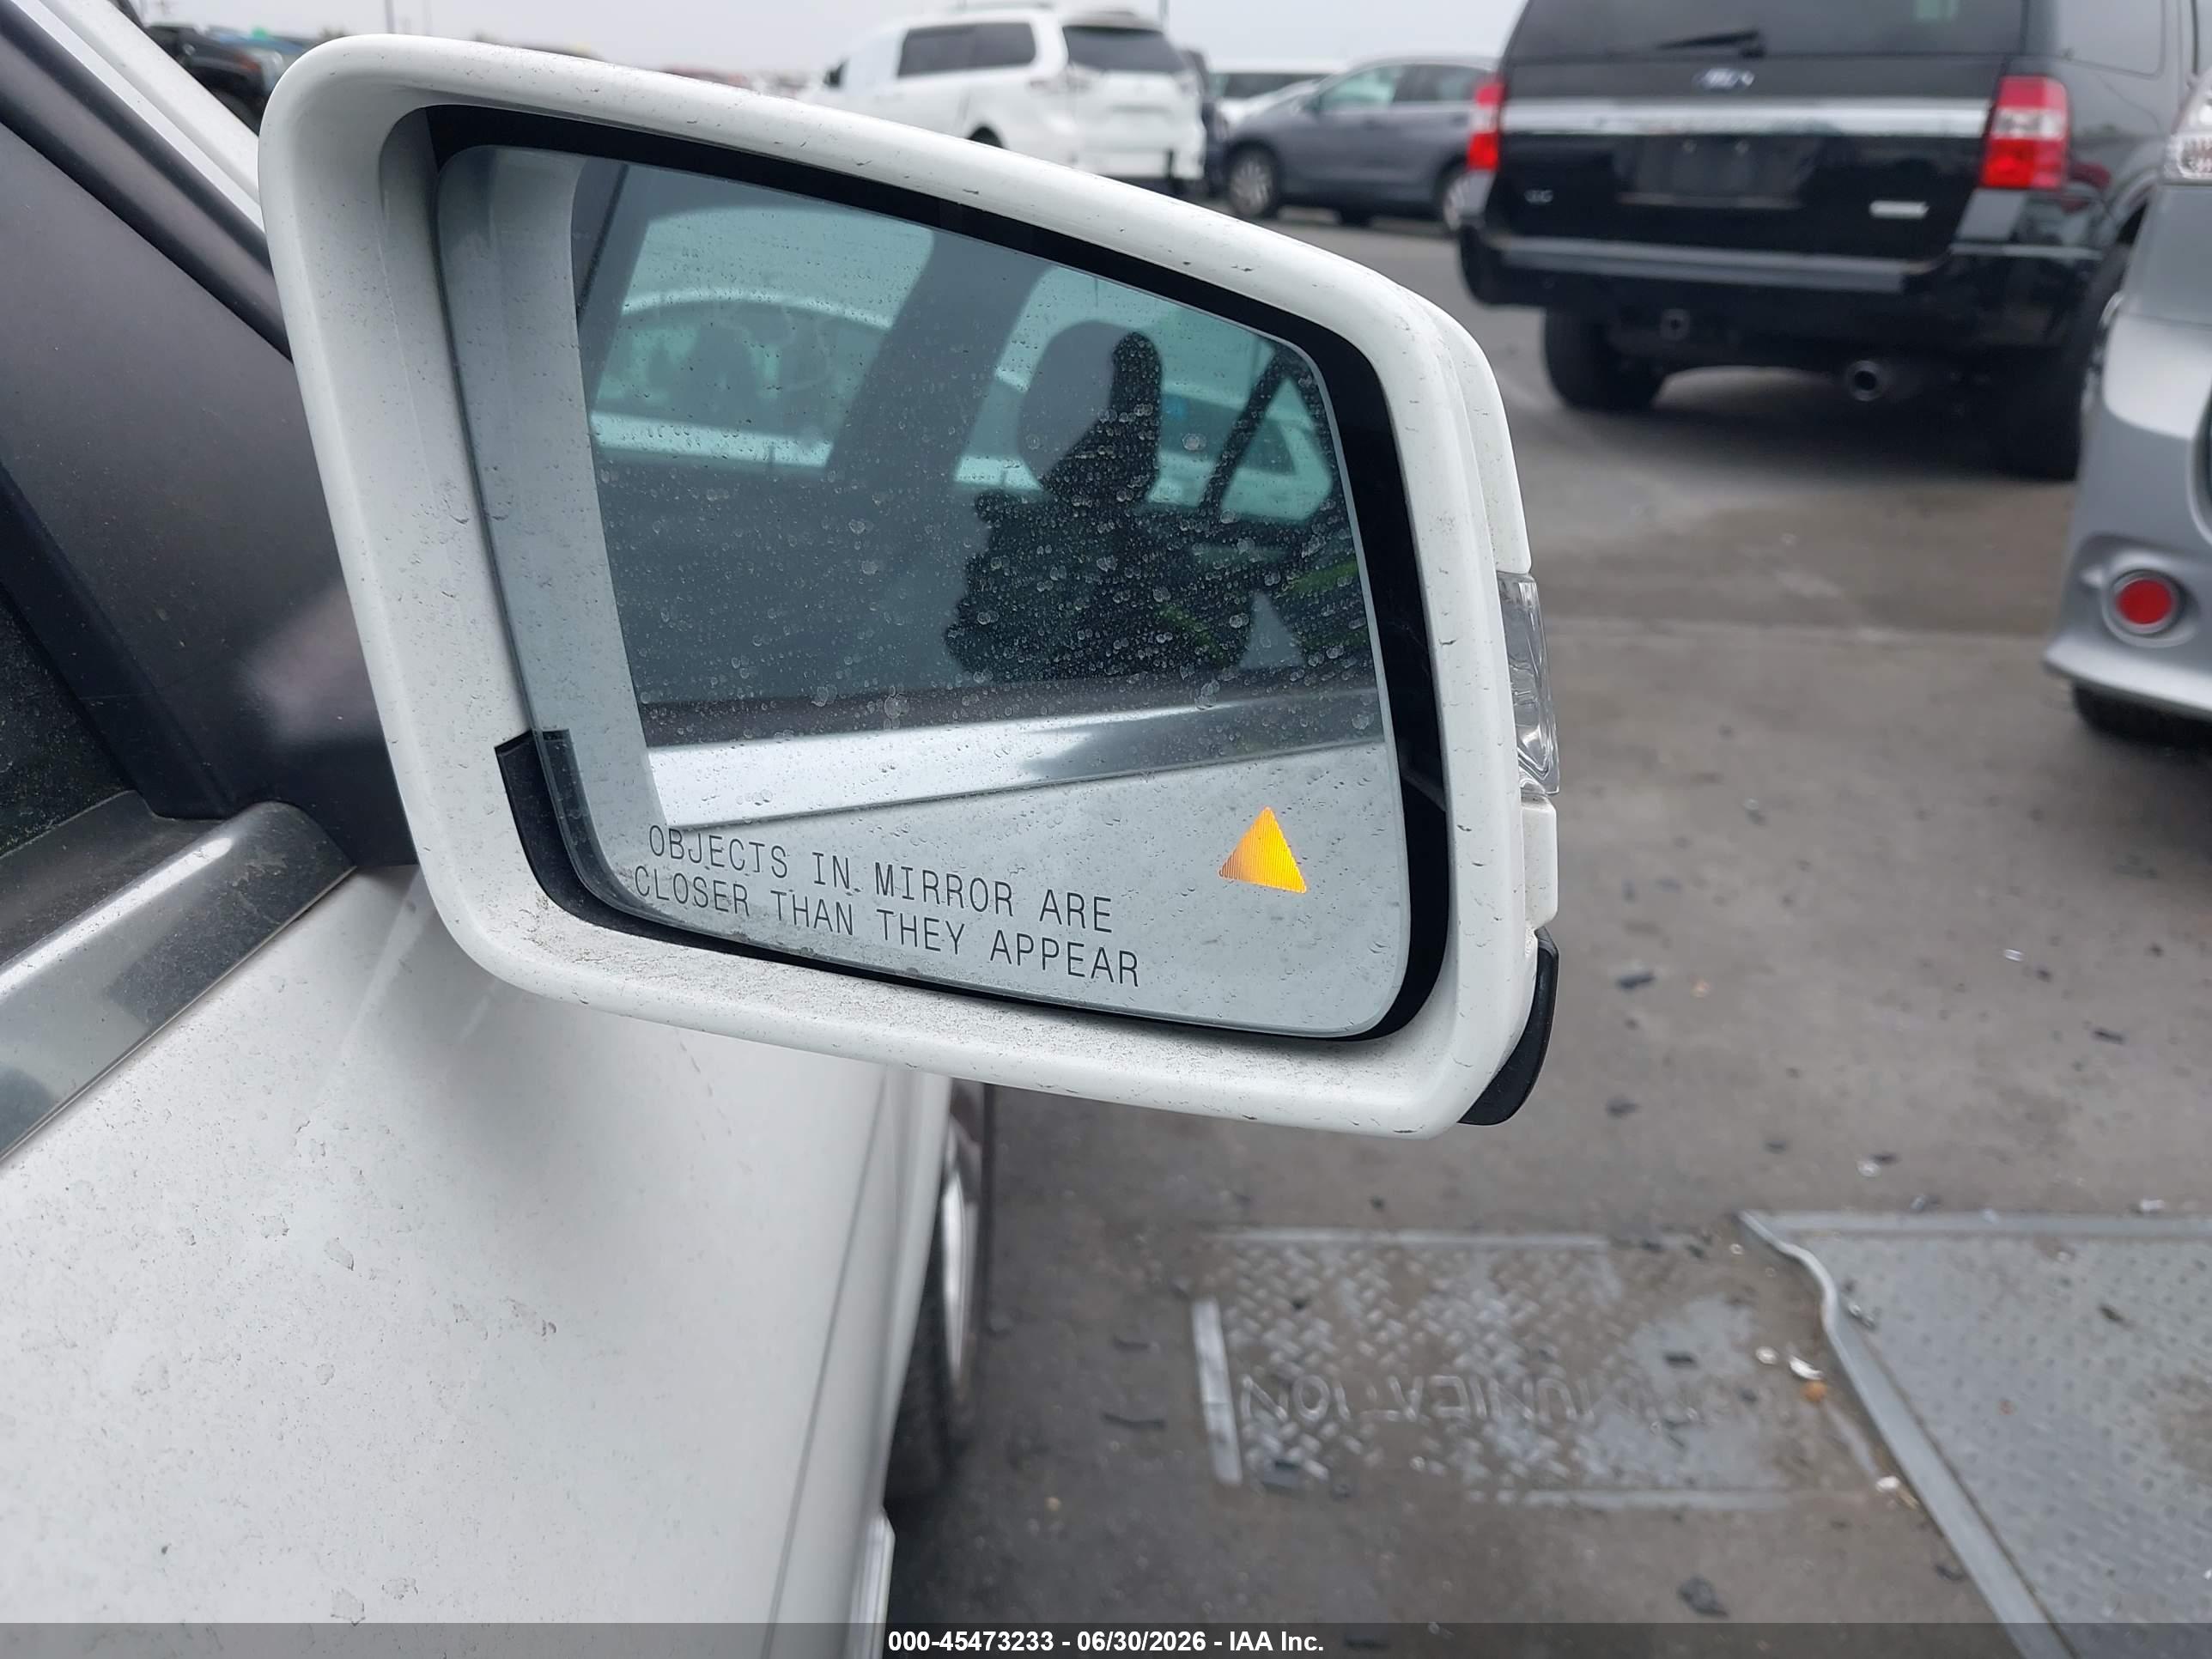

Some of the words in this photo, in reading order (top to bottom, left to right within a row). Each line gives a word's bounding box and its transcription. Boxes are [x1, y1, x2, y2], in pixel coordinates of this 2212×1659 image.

[634, 865, 750, 916] CLOSER
[769, 889, 854, 936] THAN
[876, 908, 966, 956] THEY
[989, 929, 1139, 988] APPEAR
[649, 824, 788, 878] OBJECTS
[811, 851, 850, 890] IN
[874, 861, 1014, 917] MIRROR
[1039, 889, 1113, 933] ARE
